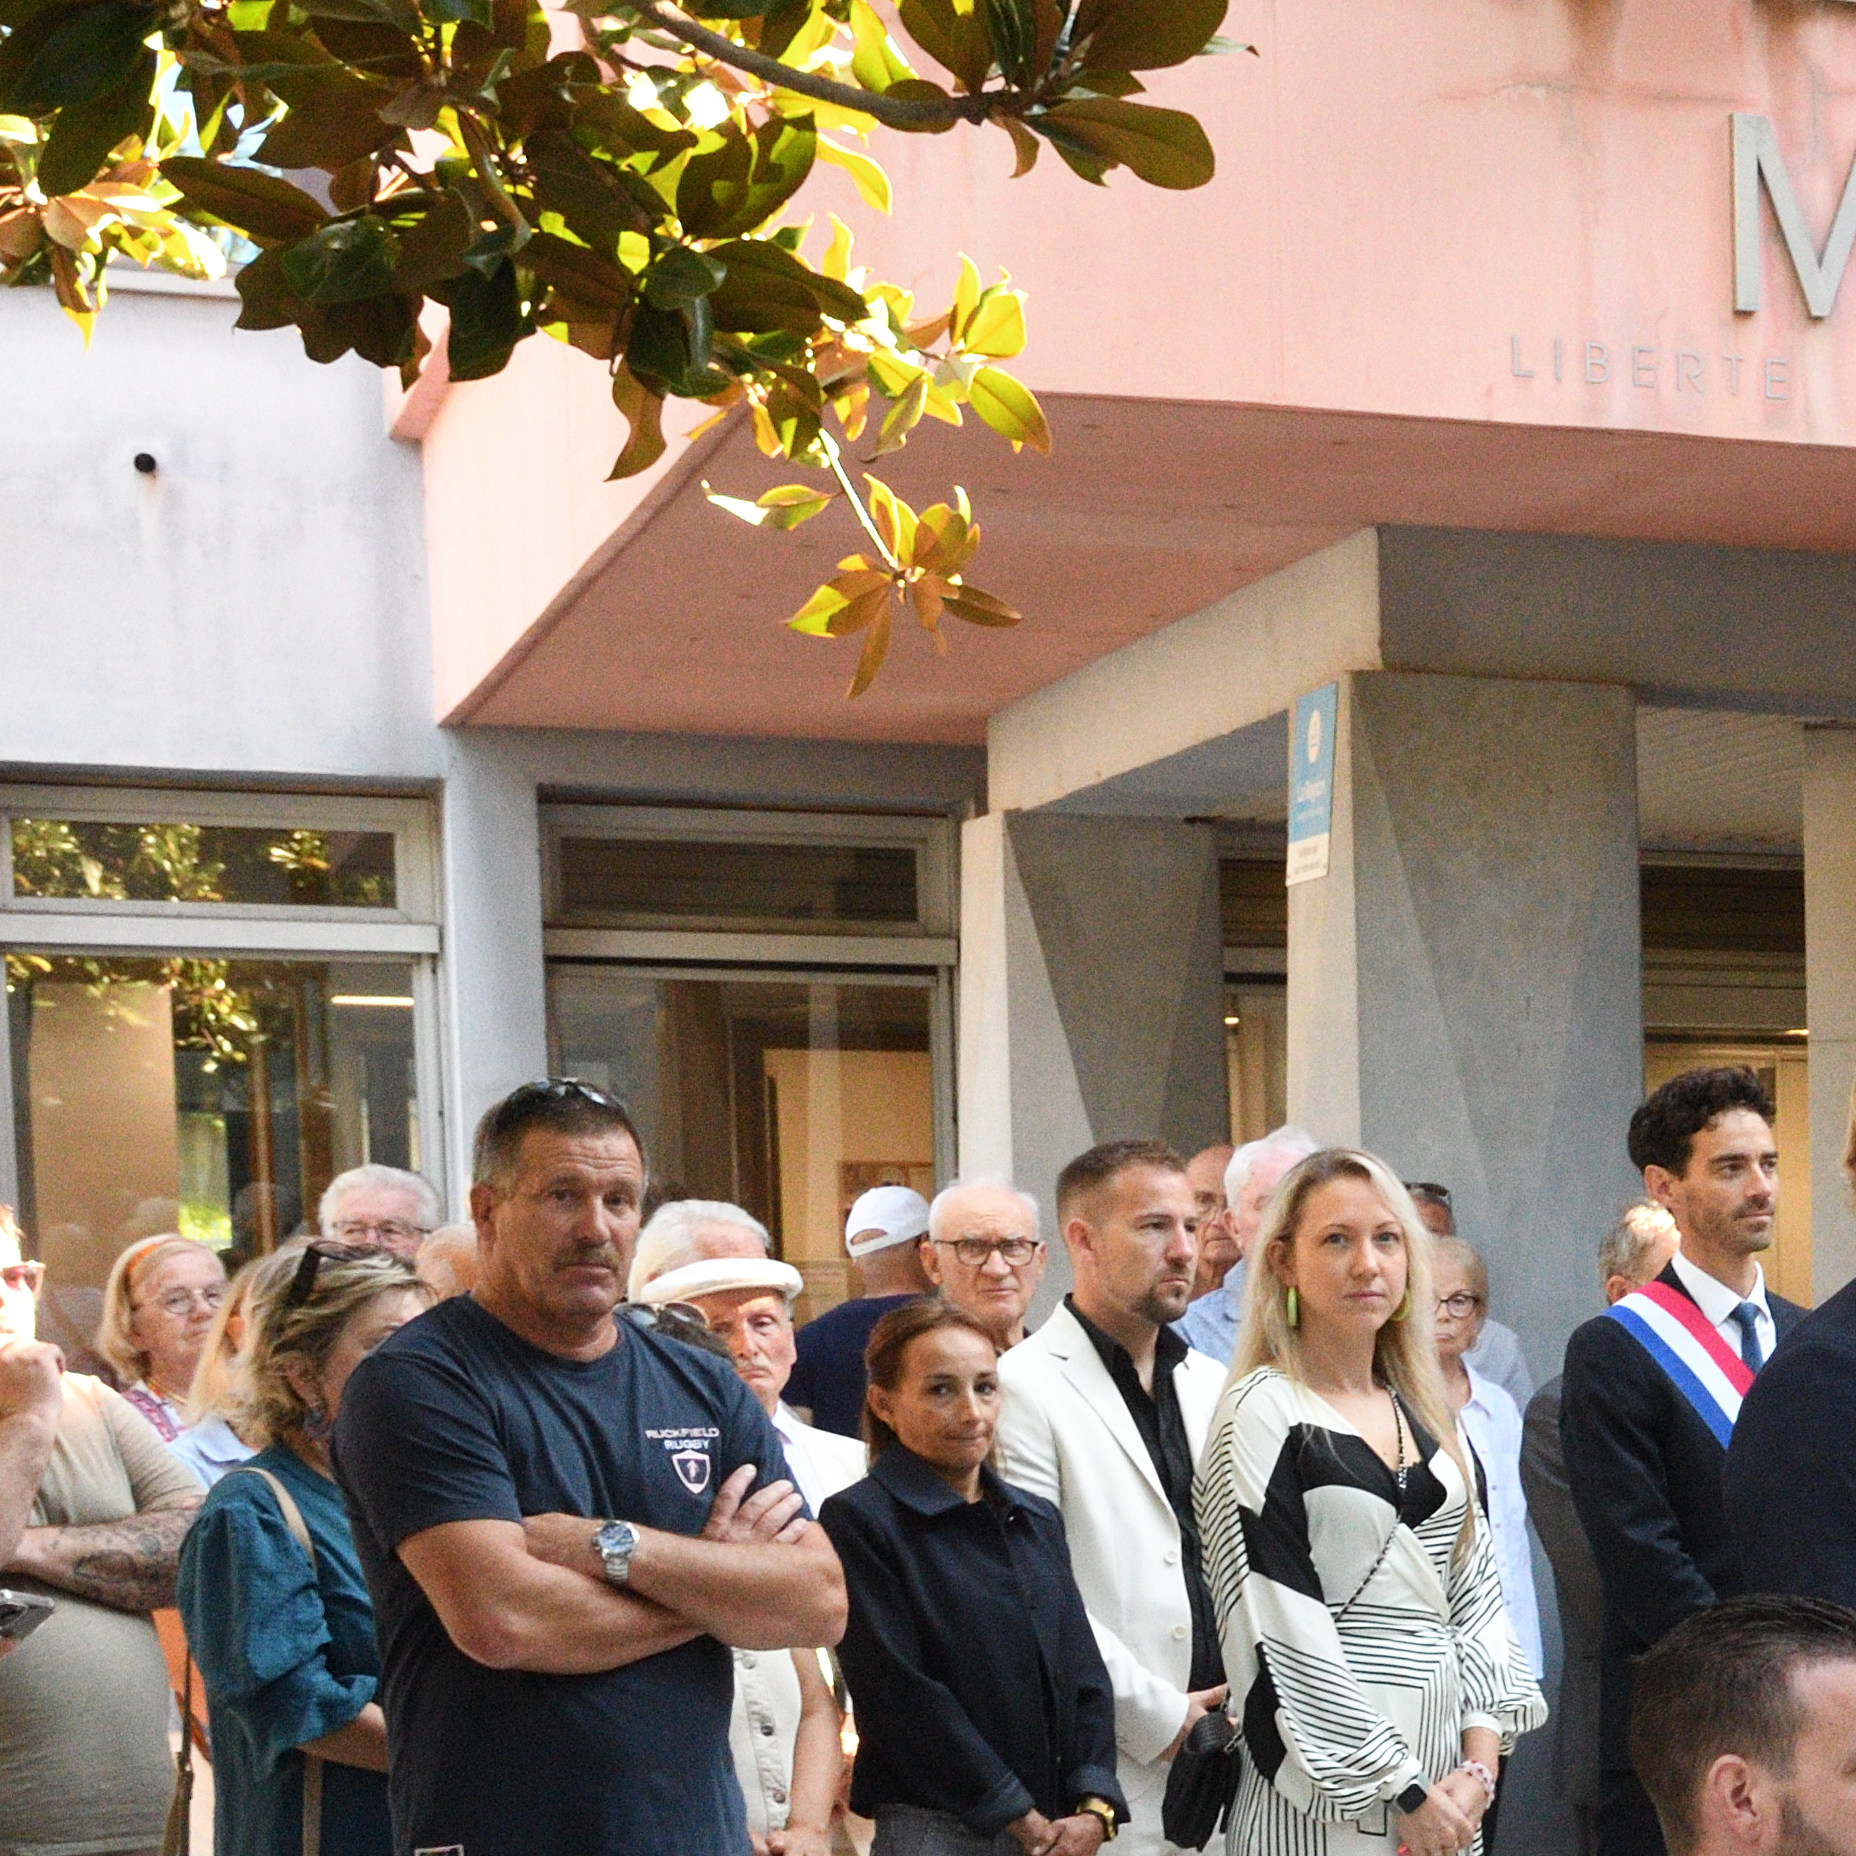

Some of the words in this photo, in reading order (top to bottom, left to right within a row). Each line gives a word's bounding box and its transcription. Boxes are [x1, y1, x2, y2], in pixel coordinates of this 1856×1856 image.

[1510, 336, 1790, 402] LIBERTE
[645, 1426, 720, 1440] RUCKFIELD
[663, 1438, 711, 1450] RUGBY
